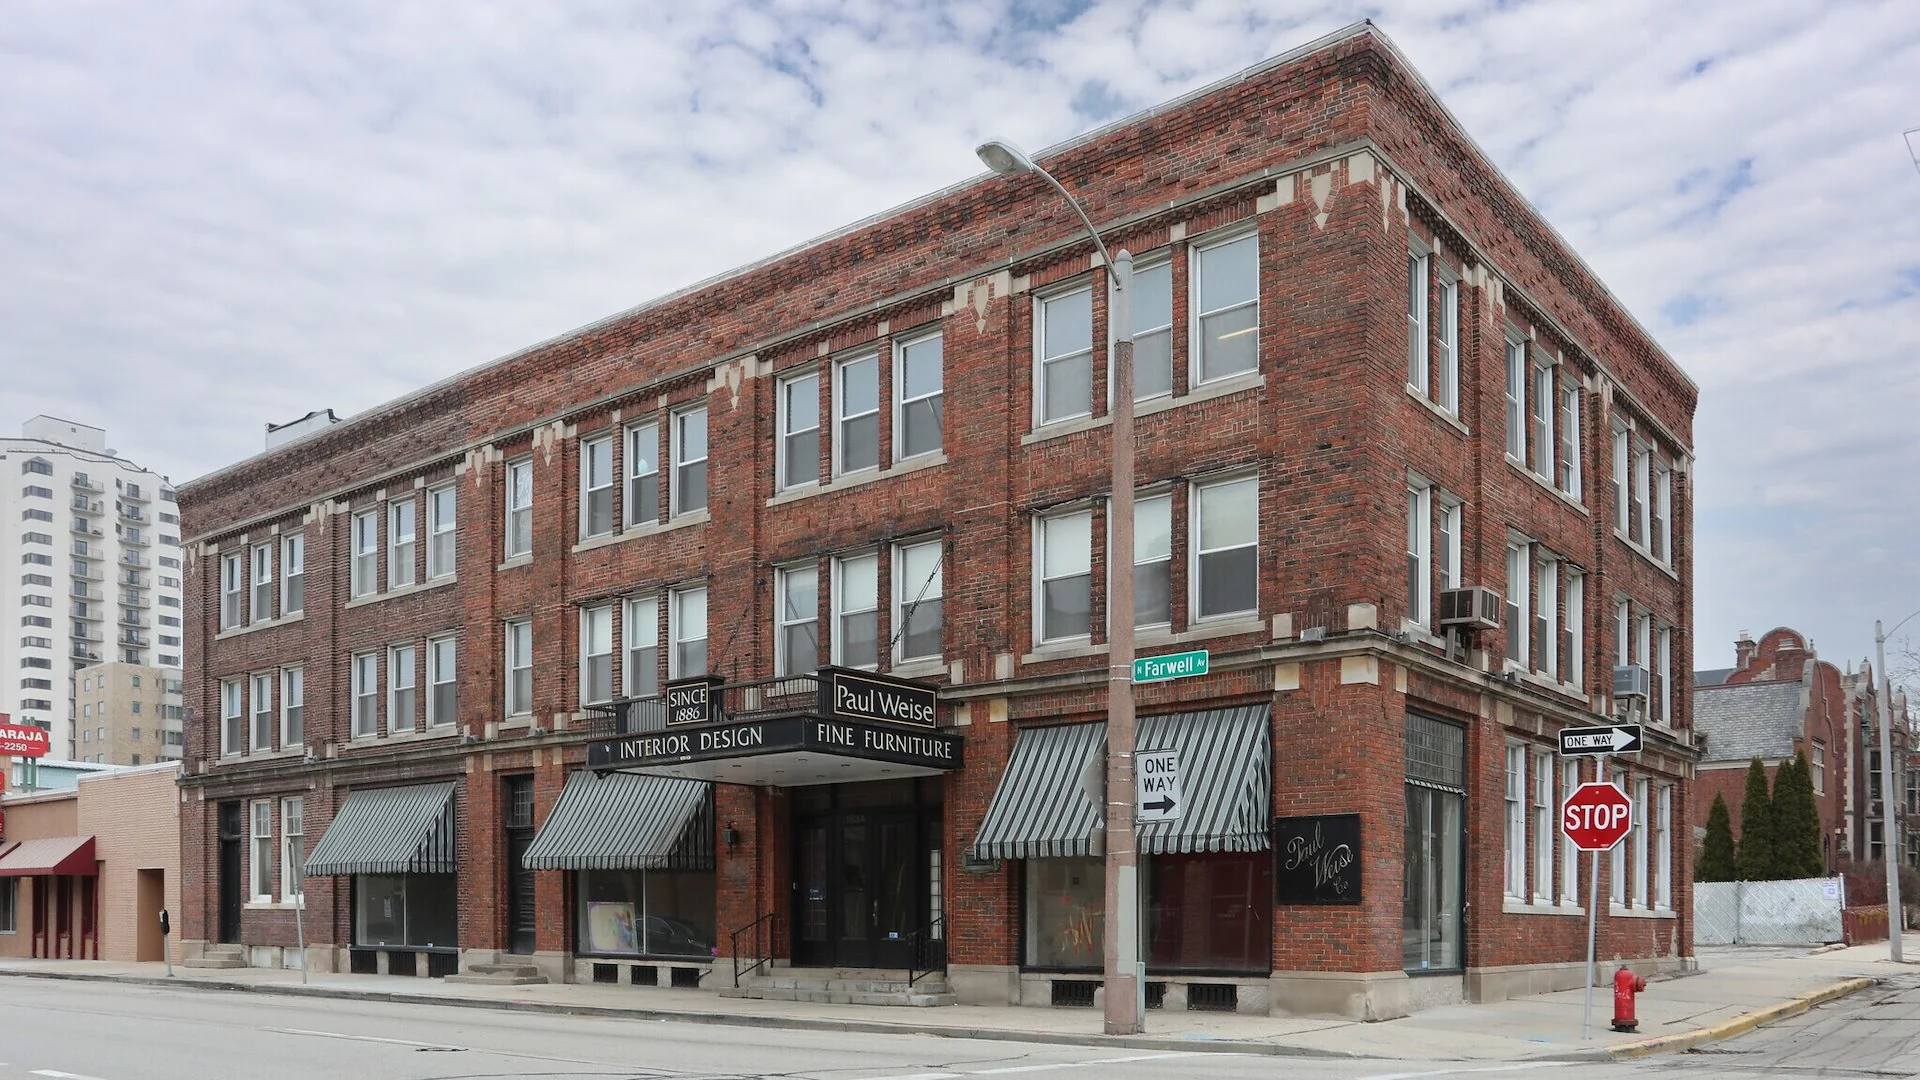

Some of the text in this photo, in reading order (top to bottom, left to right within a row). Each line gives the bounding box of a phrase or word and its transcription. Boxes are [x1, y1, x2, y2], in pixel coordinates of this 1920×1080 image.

[1137, 666, 1142, 675] N
[1144, 656, 1193, 677] Farwell
[669, 688, 706, 708] SINCE
[837, 684, 934, 723] Paul Weise
[675, 706, 701, 722] 1886
[0, 728, 44, 742] ARAJA
[620, 726, 763, 759] INTERIOR DESIGN
[817, 723, 952, 760] FINE FURNITURE
[1566, 734, 1613, 747] ONE WAY
[1145, 757, 1175, 773] ONE
[1143, 776, 1176, 793] WAY
[1565, 803, 1628, 831] STOP
[1285, 820, 1325, 871] Paul
[1309, 843, 1354, 889] Weise
